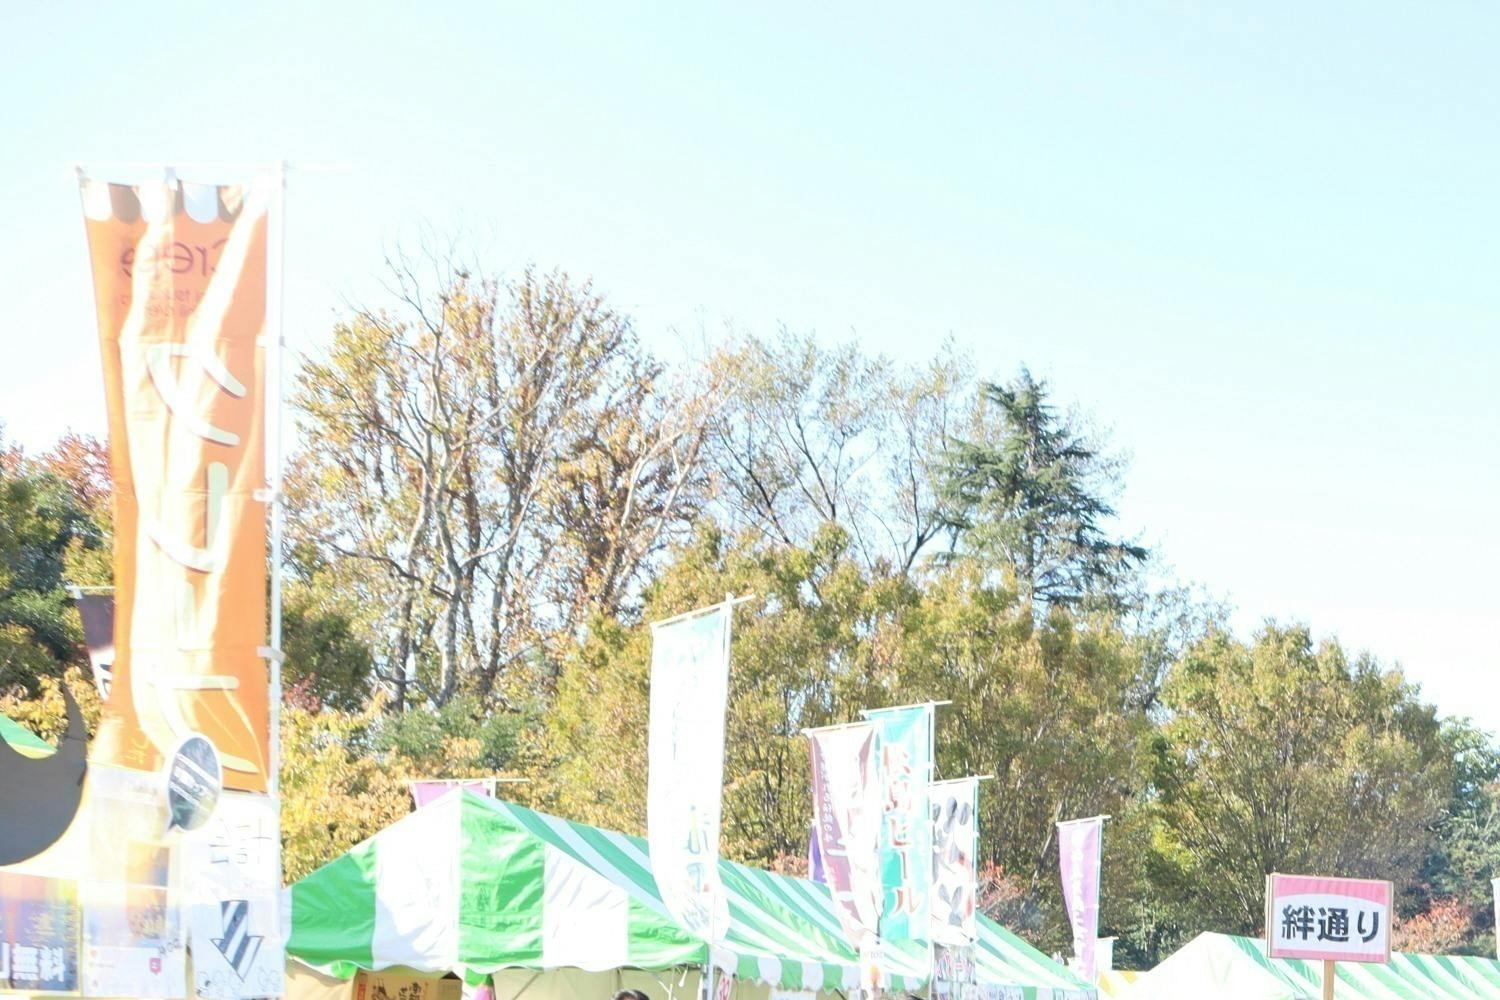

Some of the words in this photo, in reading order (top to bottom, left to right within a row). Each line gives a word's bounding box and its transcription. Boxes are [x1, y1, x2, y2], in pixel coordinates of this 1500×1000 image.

[1281, 904, 1380, 943] 絆通り
[0, 940, 65, 983] 無料
